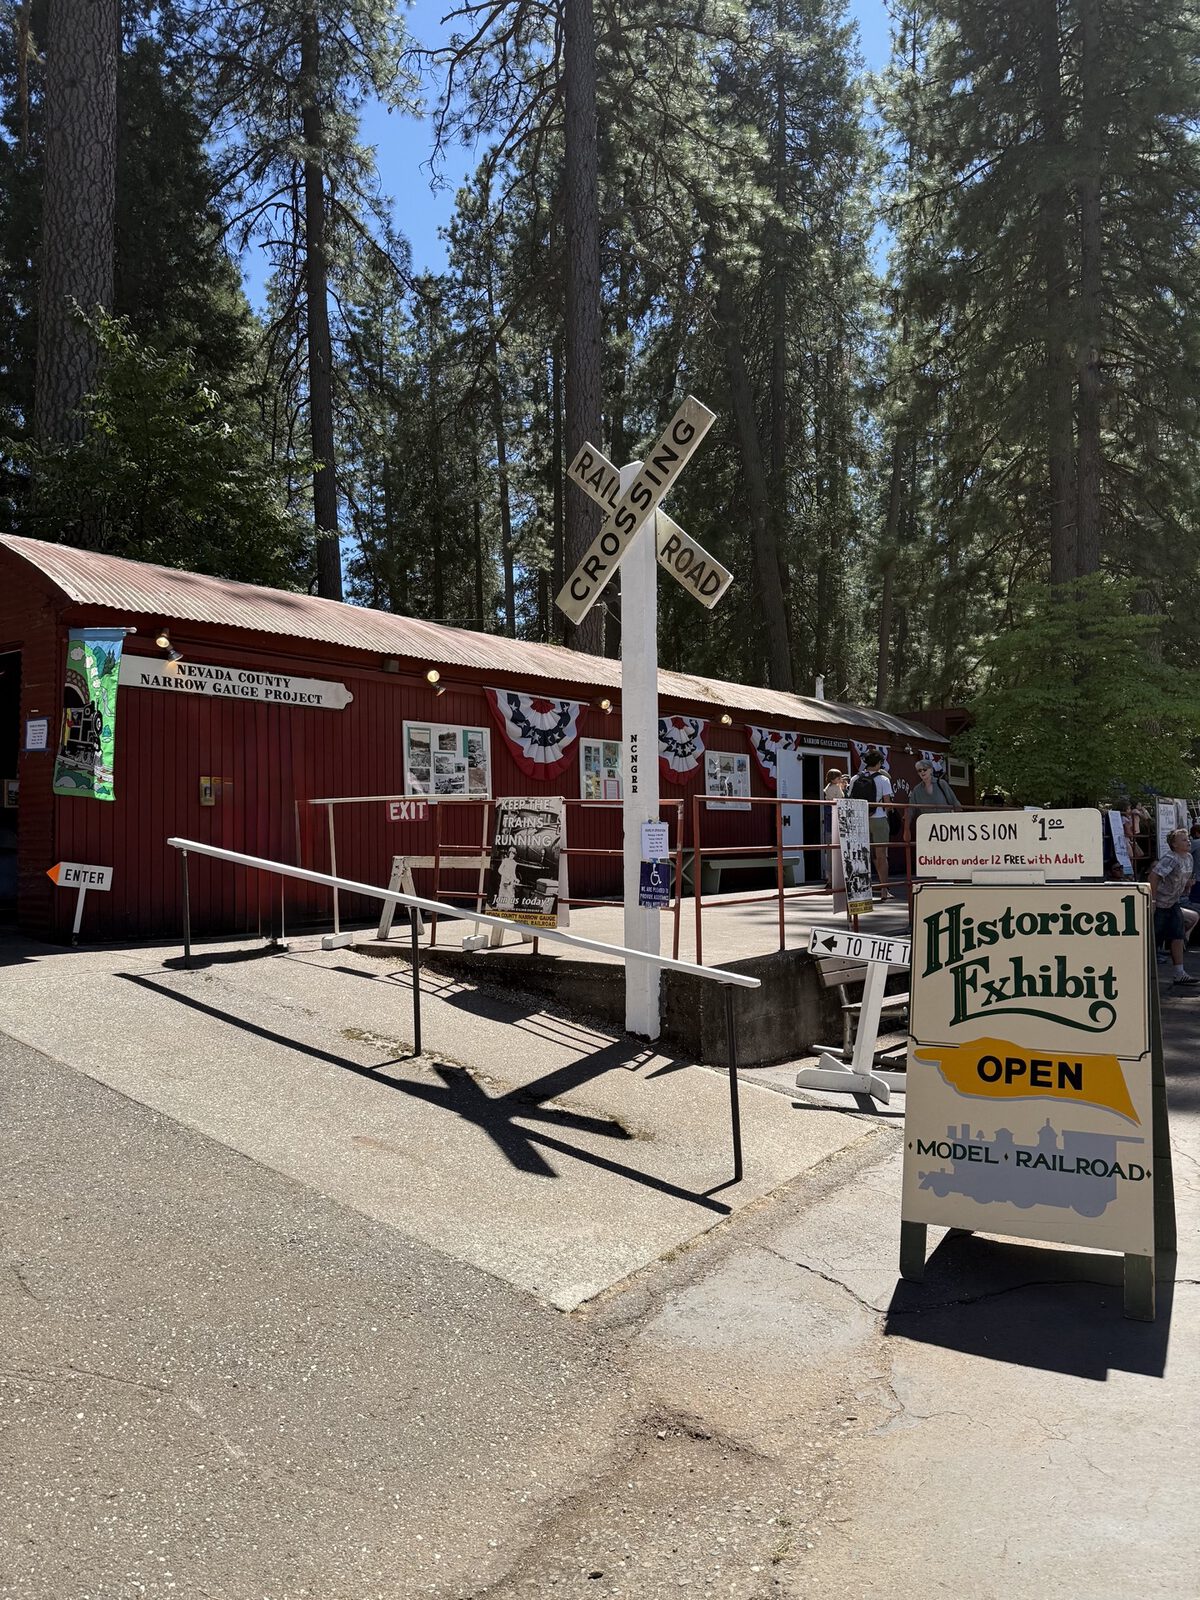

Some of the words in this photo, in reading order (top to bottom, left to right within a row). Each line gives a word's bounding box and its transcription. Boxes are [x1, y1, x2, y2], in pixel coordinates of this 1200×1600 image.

[570, 418, 696, 601] CROSSING
[574, 450, 621, 509] RAIL
[660, 534, 721, 596] ROAD
[140, 673, 207, 692] NARROW
[212, 682, 259, 698] GAUGE
[265, 688, 323, 705] PROJECT
[176, 663, 233, 682] NEVADA
[238, 672, 291, 689] COUNTY
[630, 734, 638, 794] NCNGRR
[389, 800, 427, 821] EXIT
[501, 799, 526, 811] KEEP
[528, 799, 550, 811] THE
[503, 814, 544, 829] TRAINS
[928, 823, 1018, 842] ADMISSION
[494, 834, 552, 847] RUNNING
[918, 855, 959, 866] Children
[961, 855, 990, 866] under
[991, 854, 1001, 865] 12
[1003, 854, 1027, 865] FREE
[1027, 854, 1051, 865] with
[1054, 854, 1085, 865] Adult
[64, 868, 105, 885] ENTER
[491, 894, 507, 905] Join
[510, 896, 520, 905] us
[518, 913, 538, 921] NARROW
[921, 894, 1140, 979] Historical
[846, 936, 863, 957] TO
[870, 940, 895, 962] THE
[902, 945, 911, 964] T
[949, 955, 1119, 1027] Exhibit
[976, 1054, 1083, 1091] OPEN
[916, 1138, 1000, 1165] MODEL
[1015, 1150, 1145, 1182] RAILROAD
